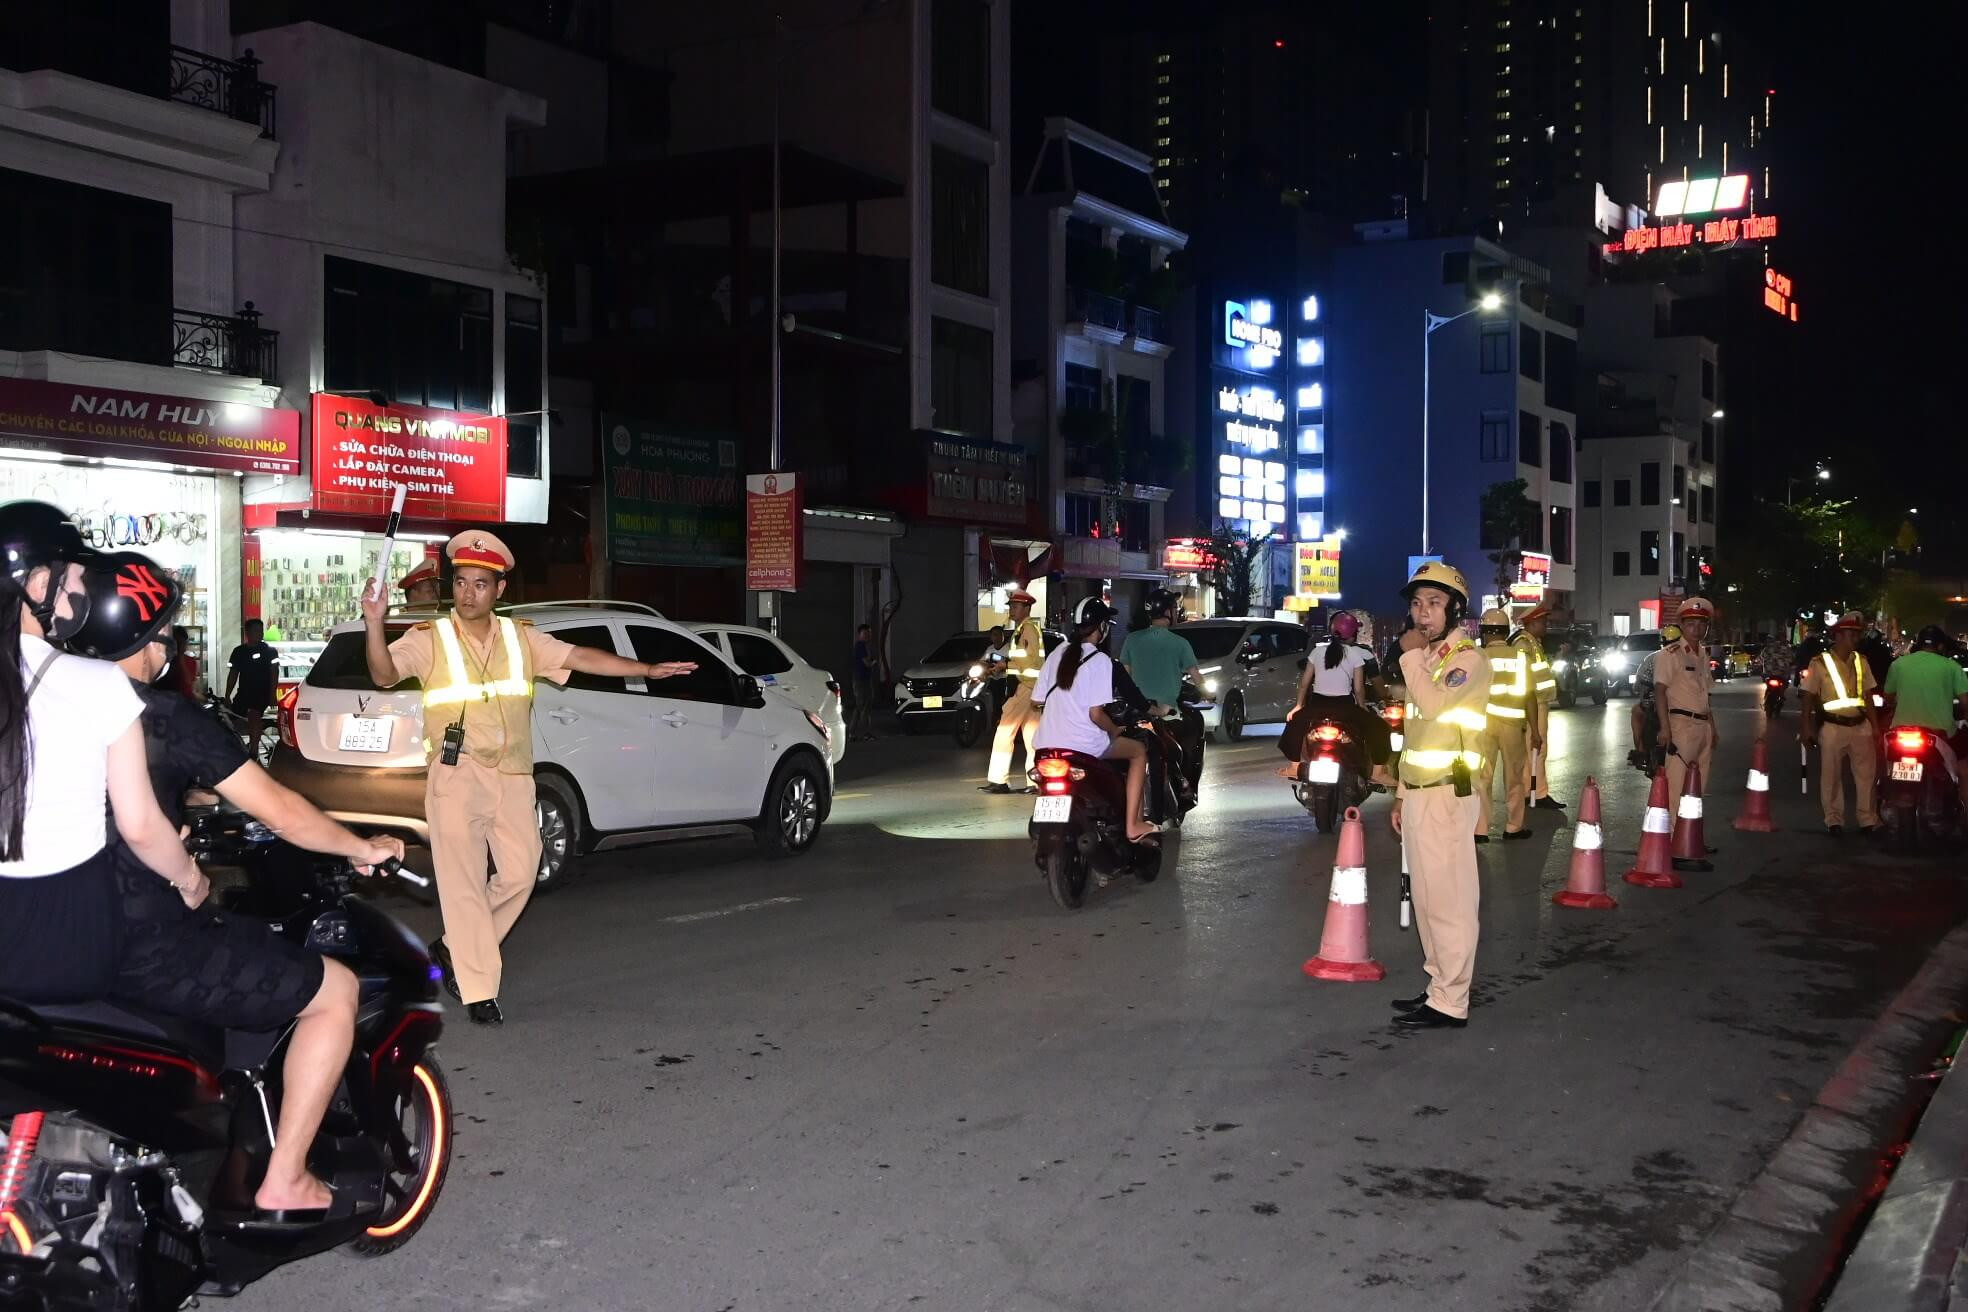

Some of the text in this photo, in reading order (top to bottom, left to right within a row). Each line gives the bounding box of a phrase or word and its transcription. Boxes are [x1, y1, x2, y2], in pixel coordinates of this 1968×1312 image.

[1661, 222, 1694, 247] MÁY
[1705, 216, 1739, 242] MÁY
[70, 394, 220, 427] NAM HUY
[335, 411, 402, 435] QUANG
[217, 435, 254, 453] NGOẠI
[255, 437, 287, 455] NHẬP
[339, 438, 474, 467] SỬA CHỮA ĐIỆN THOẠI
[339, 454, 364, 470] LẮP
[392, 463, 445, 478] CAMERA
[339, 476, 454, 495] PHỤ KIỆN SIM THẺ
